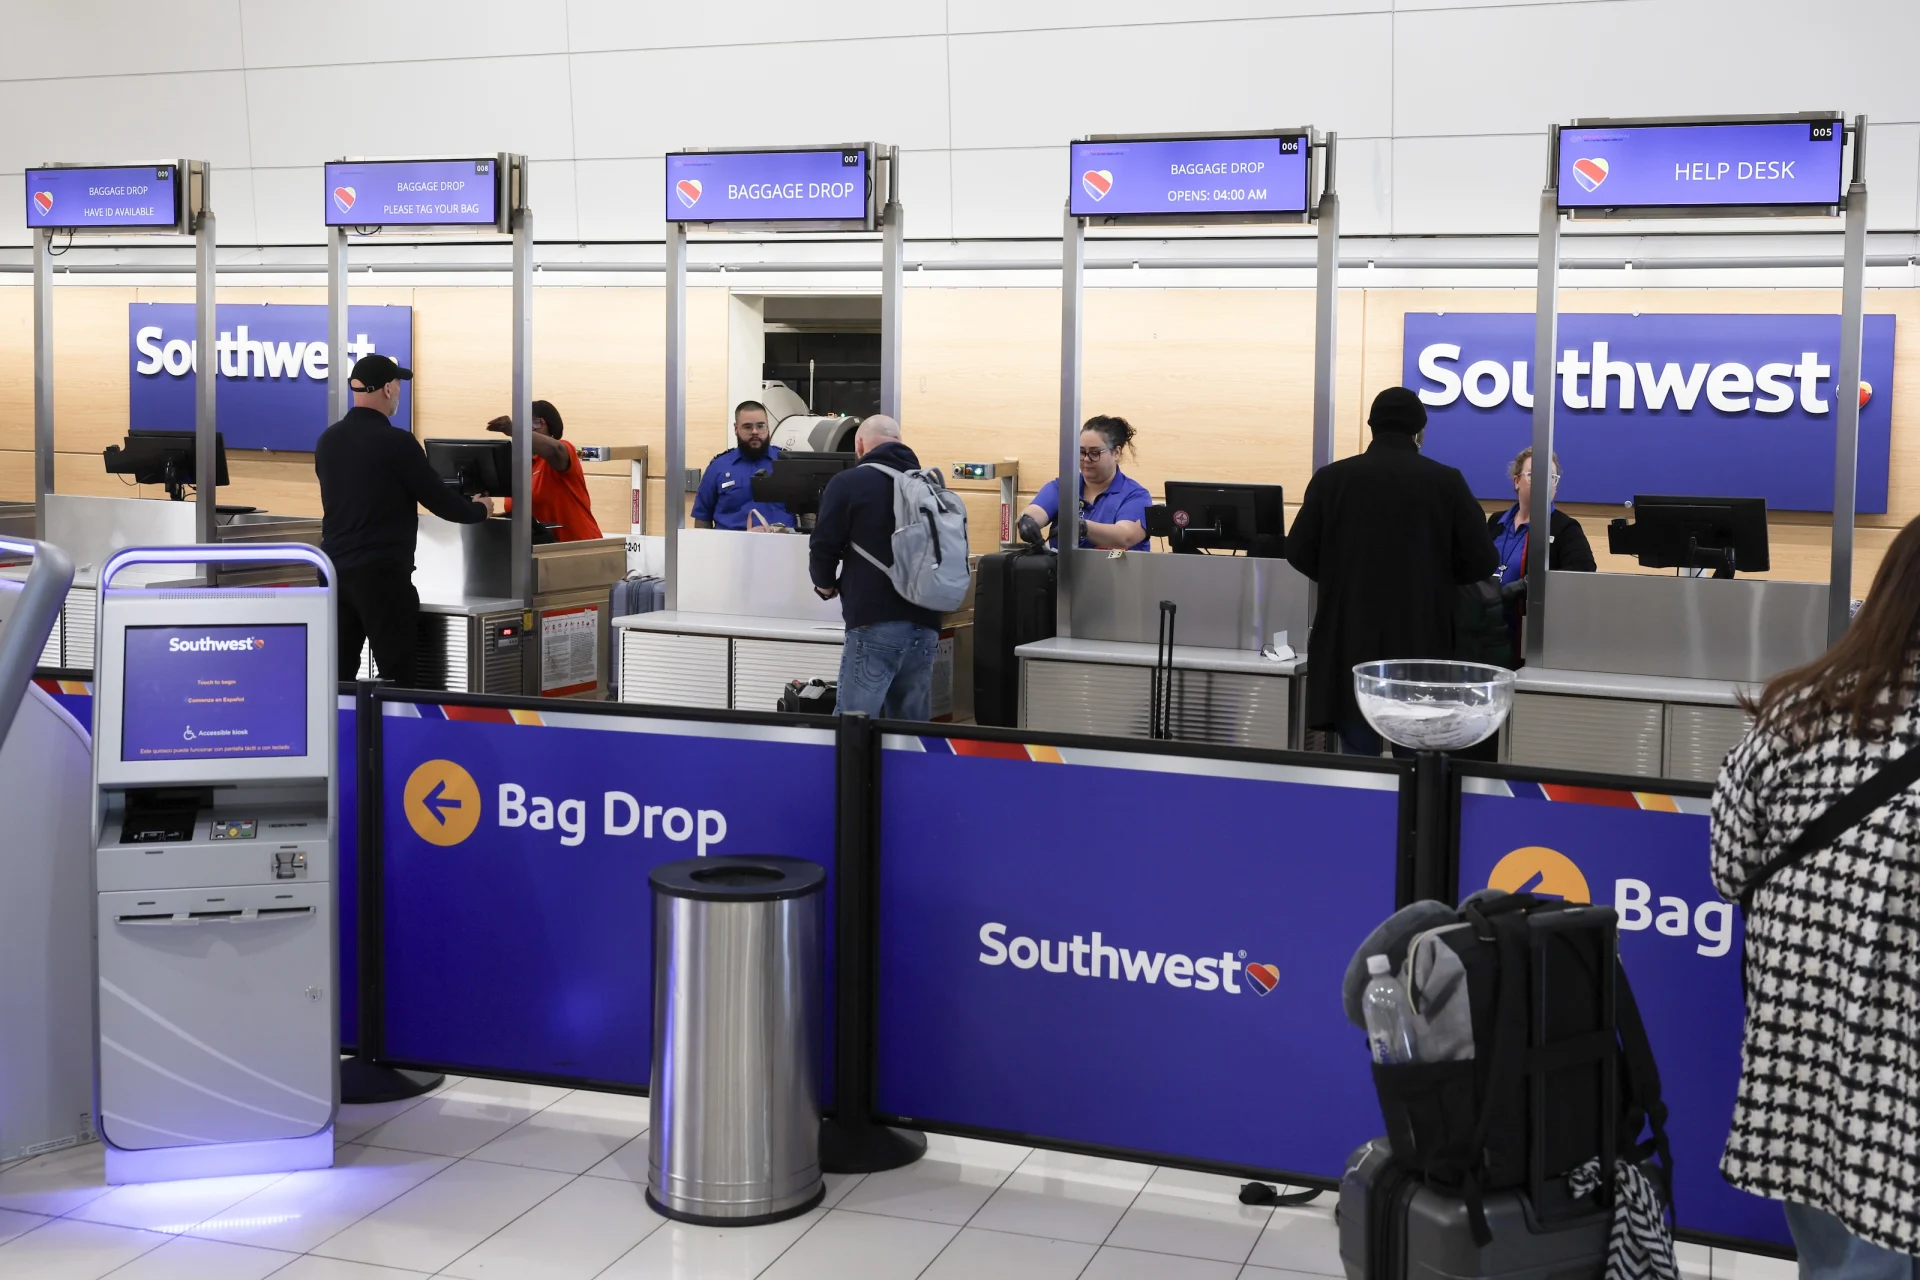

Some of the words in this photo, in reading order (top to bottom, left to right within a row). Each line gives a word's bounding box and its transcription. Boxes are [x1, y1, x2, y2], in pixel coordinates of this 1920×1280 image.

[1813, 128, 1832, 137] 005
[1282, 142, 1298, 151] 006
[844, 155, 858, 163] 007
[1171, 163, 1227, 175] BAGGAGE
[1231, 162, 1265, 174] DROP
[1675, 162, 1730, 181] HELP
[1737, 161, 1795, 180] DESK
[89, 186, 125, 196] BAGGAGE
[127, 186, 148, 195] DROP
[397, 182, 438, 192] BAGGAGE
[440, 181, 465, 191] DROP
[728, 184, 803, 199] BAGGAGE
[809, 182, 854, 198] DROP
[1167, 190, 1210, 202] OPENS:
[1213, 189, 1245, 201] 04:00
[1247, 189, 1267, 200] AM
[84, 208, 103, 217] HAVE
[105, 208, 114, 217] ID
[116, 207, 154, 216] AVAILABLE
[383, 204, 414, 214] PLEASE
[415, 204, 433, 214] TAG
[434, 204, 459, 214] YOUR
[461, 203, 479, 213] BAG
[498, 782, 586, 847] Bag
[603, 791, 728, 857] Drop
[1614, 878, 1733, 957] Bag
